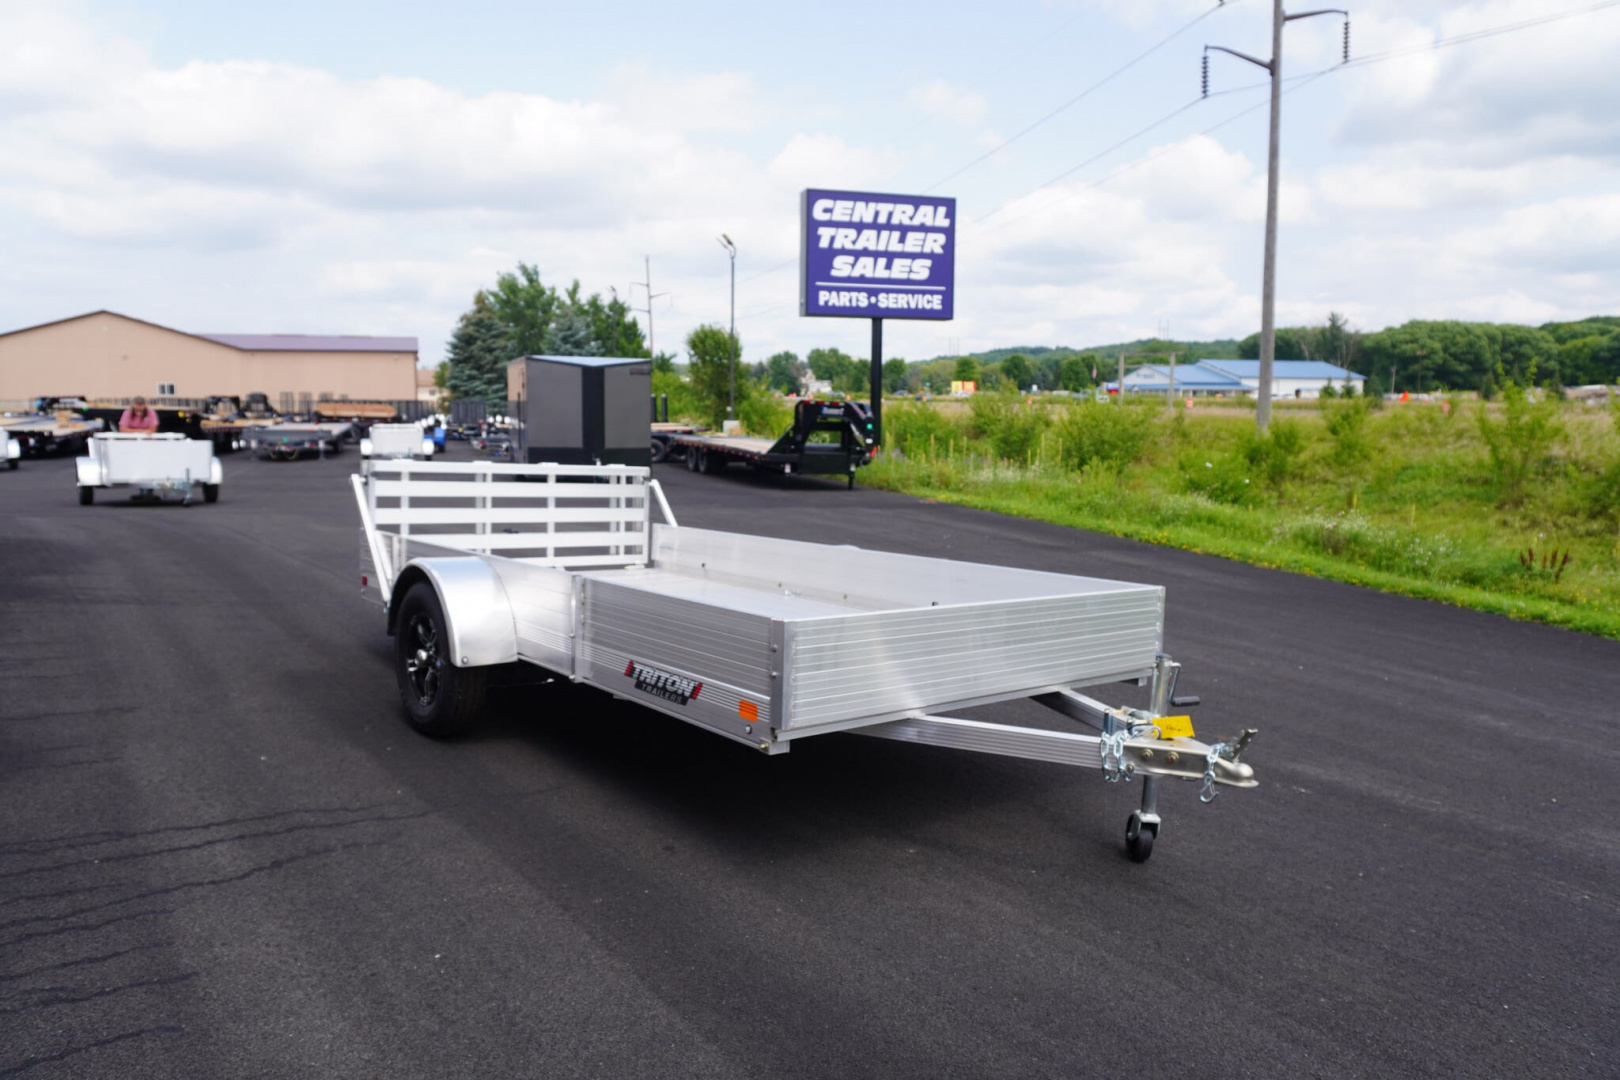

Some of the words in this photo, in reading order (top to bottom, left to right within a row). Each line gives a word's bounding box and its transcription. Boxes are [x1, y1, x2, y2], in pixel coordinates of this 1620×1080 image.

[812, 199, 950, 227] CENTRAL
[817, 226, 946, 254] TRAILER
[830, 255, 932, 280] SALES
[818, 290, 869, 308] PARTS
[877, 292, 943, 310] SERVICE
[633, 662, 696, 697] TRITON
[641, 683, 683, 704] TRAILERS
